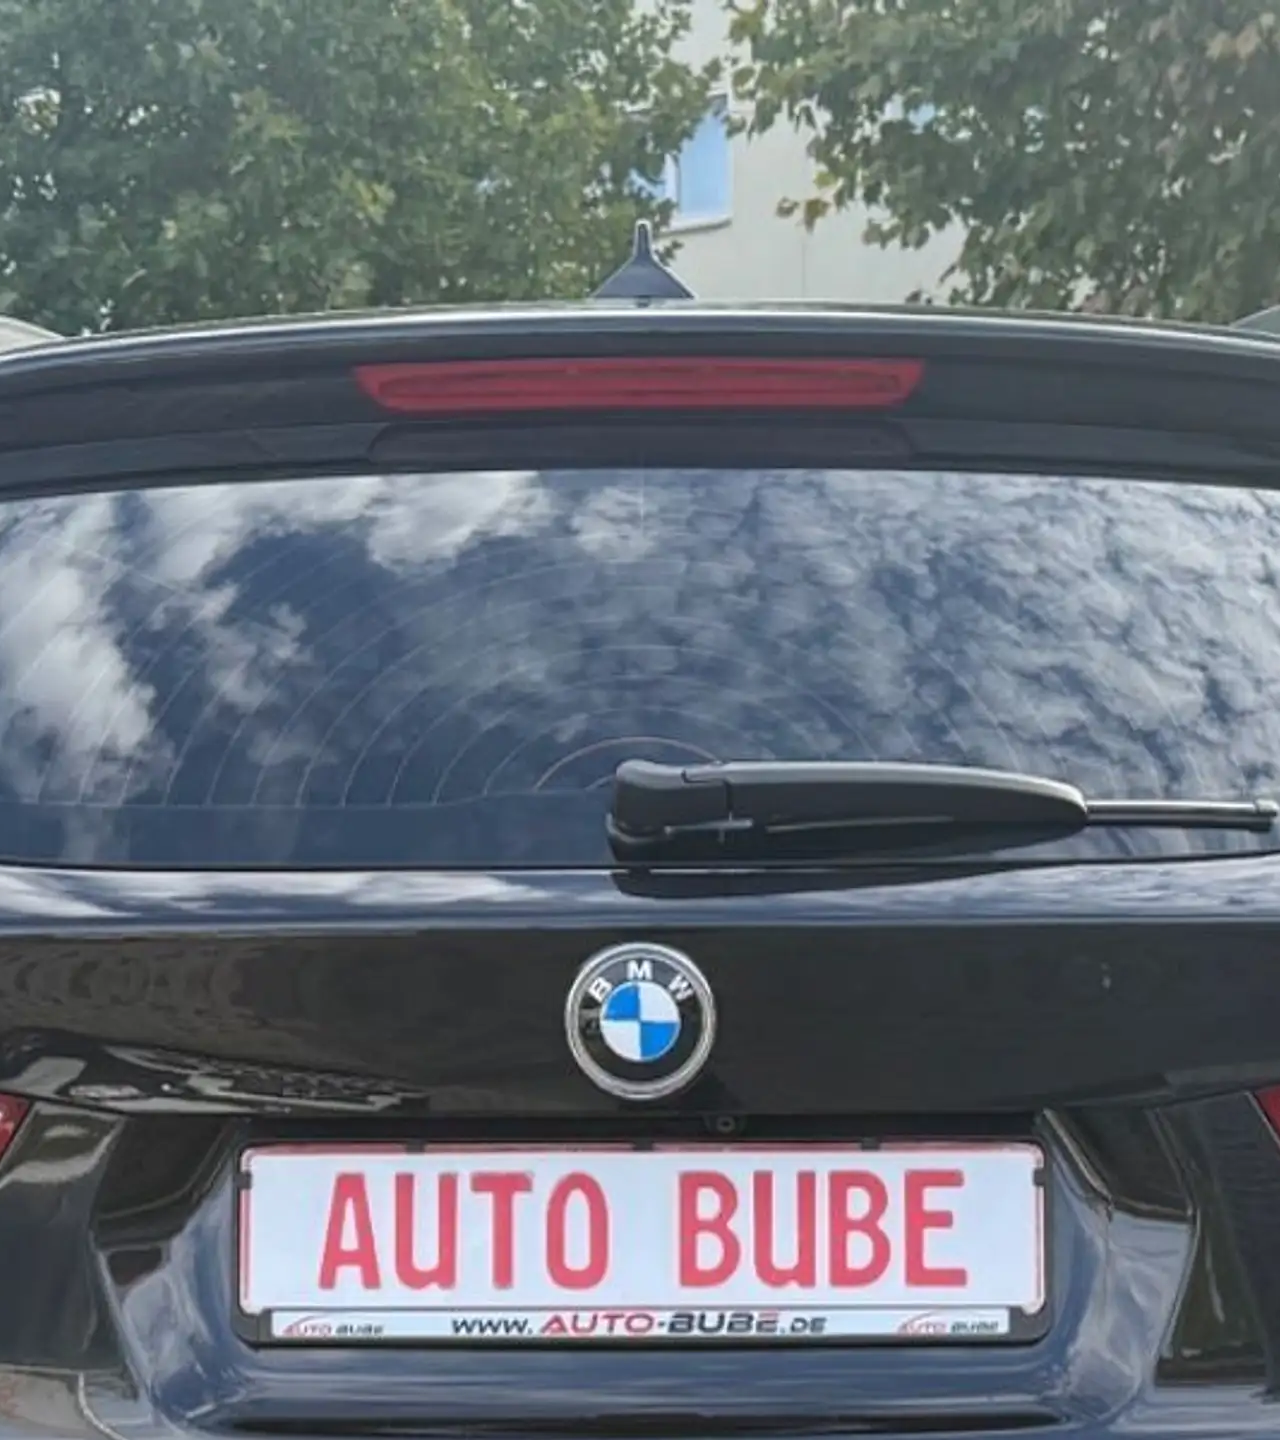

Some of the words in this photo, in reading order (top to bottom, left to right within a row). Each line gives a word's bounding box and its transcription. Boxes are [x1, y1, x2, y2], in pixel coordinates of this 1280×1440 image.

[588, 960, 694, 1002] BMW
[320, 1173, 608, 1290] AUTO
[679, 1171, 966, 1288] BUBE
